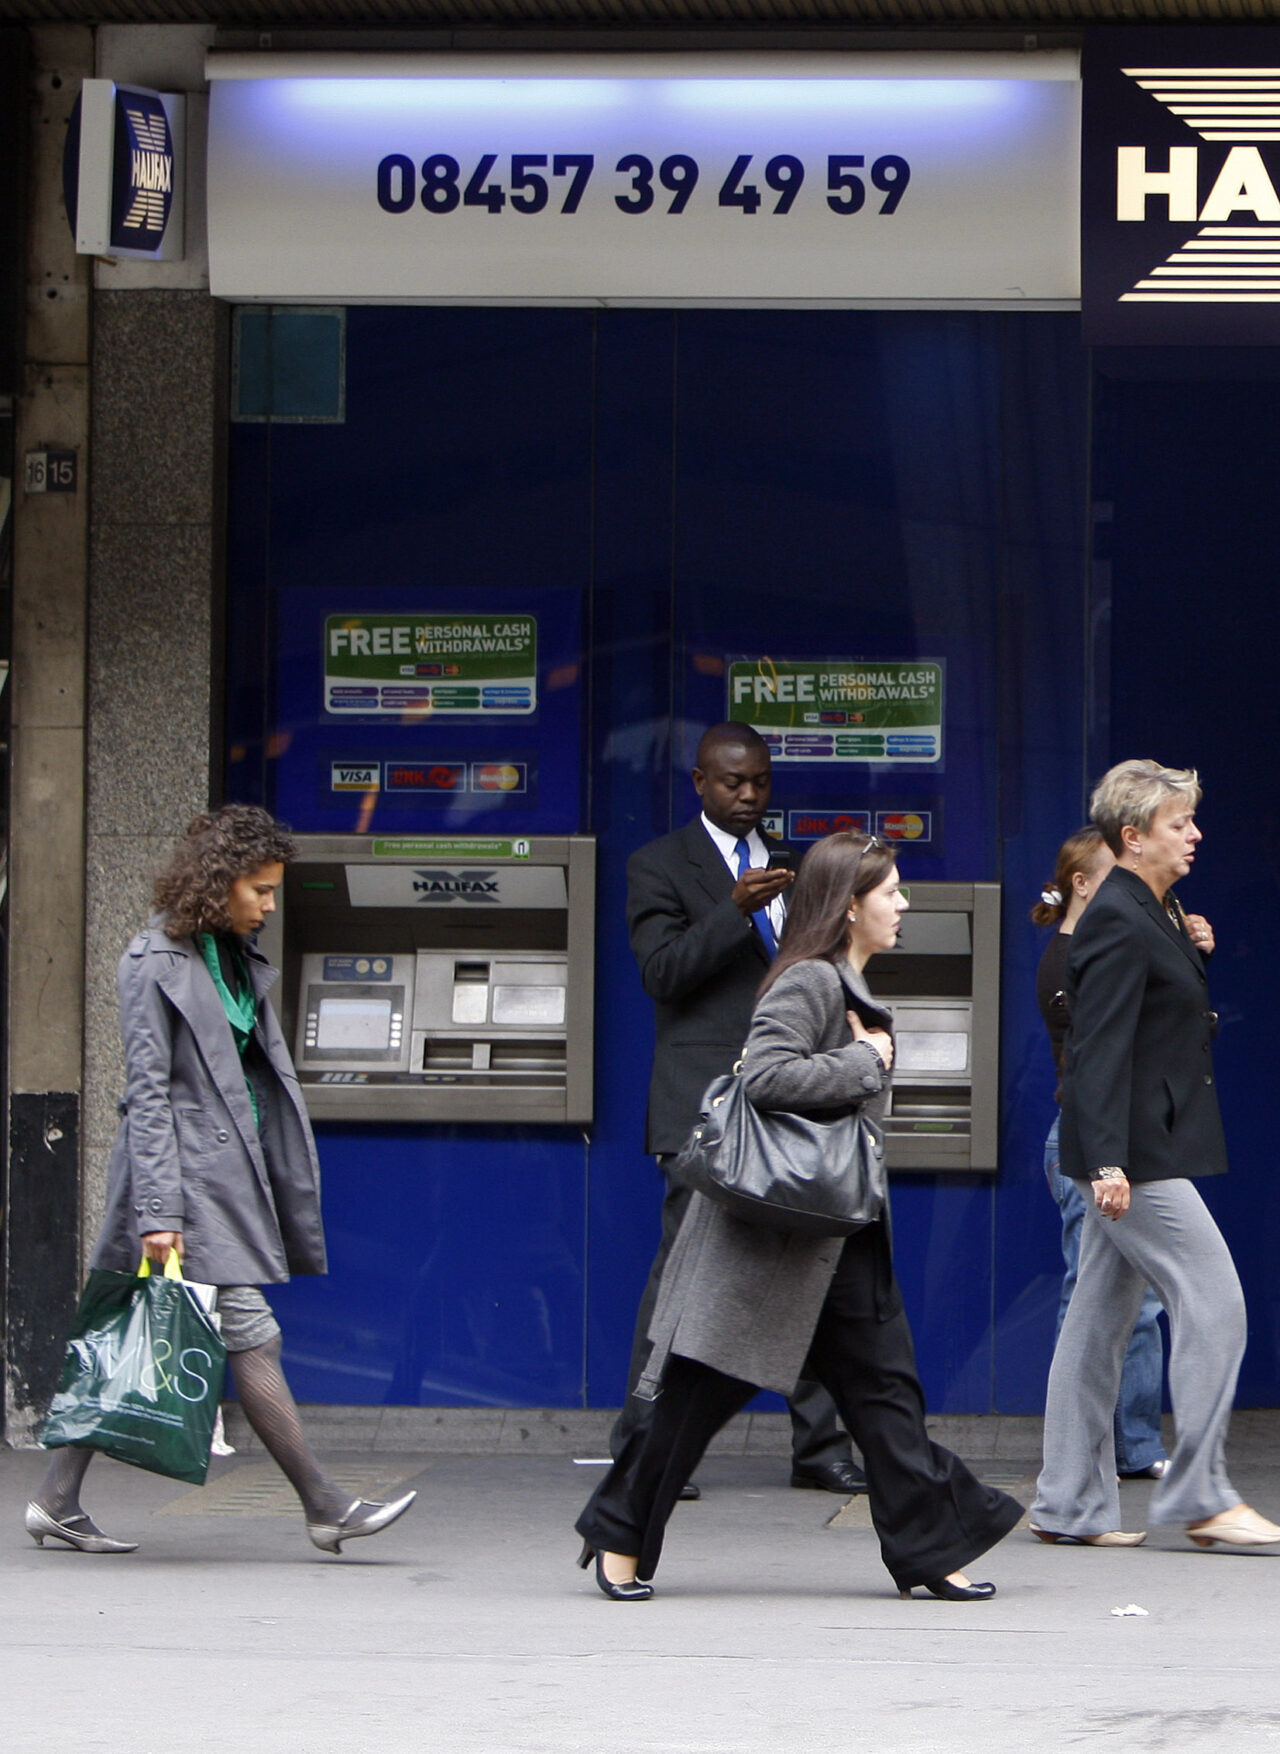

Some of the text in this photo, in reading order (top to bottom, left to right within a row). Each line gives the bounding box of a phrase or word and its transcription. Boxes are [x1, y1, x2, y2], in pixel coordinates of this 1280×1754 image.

[132, 149, 172, 193] HALIFAX
[376, 154, 912, 216] 08457 39 49 59
[29, 461, 44, 483] 16
[49, 460, 74, 485] 15
[330, 627, 412, 656] FREE
[415, 626, 491, 639] PERSONAL
[493, 623, 531, 637] CASH
[734, 675, 816, 704] FREE
[819, 673, 896, 687] PERSONAL
[898, 671, 936, 685] CASH
[339, 771, 372, 782] VISA
[413, 881, 499, 892] HALIFAX
